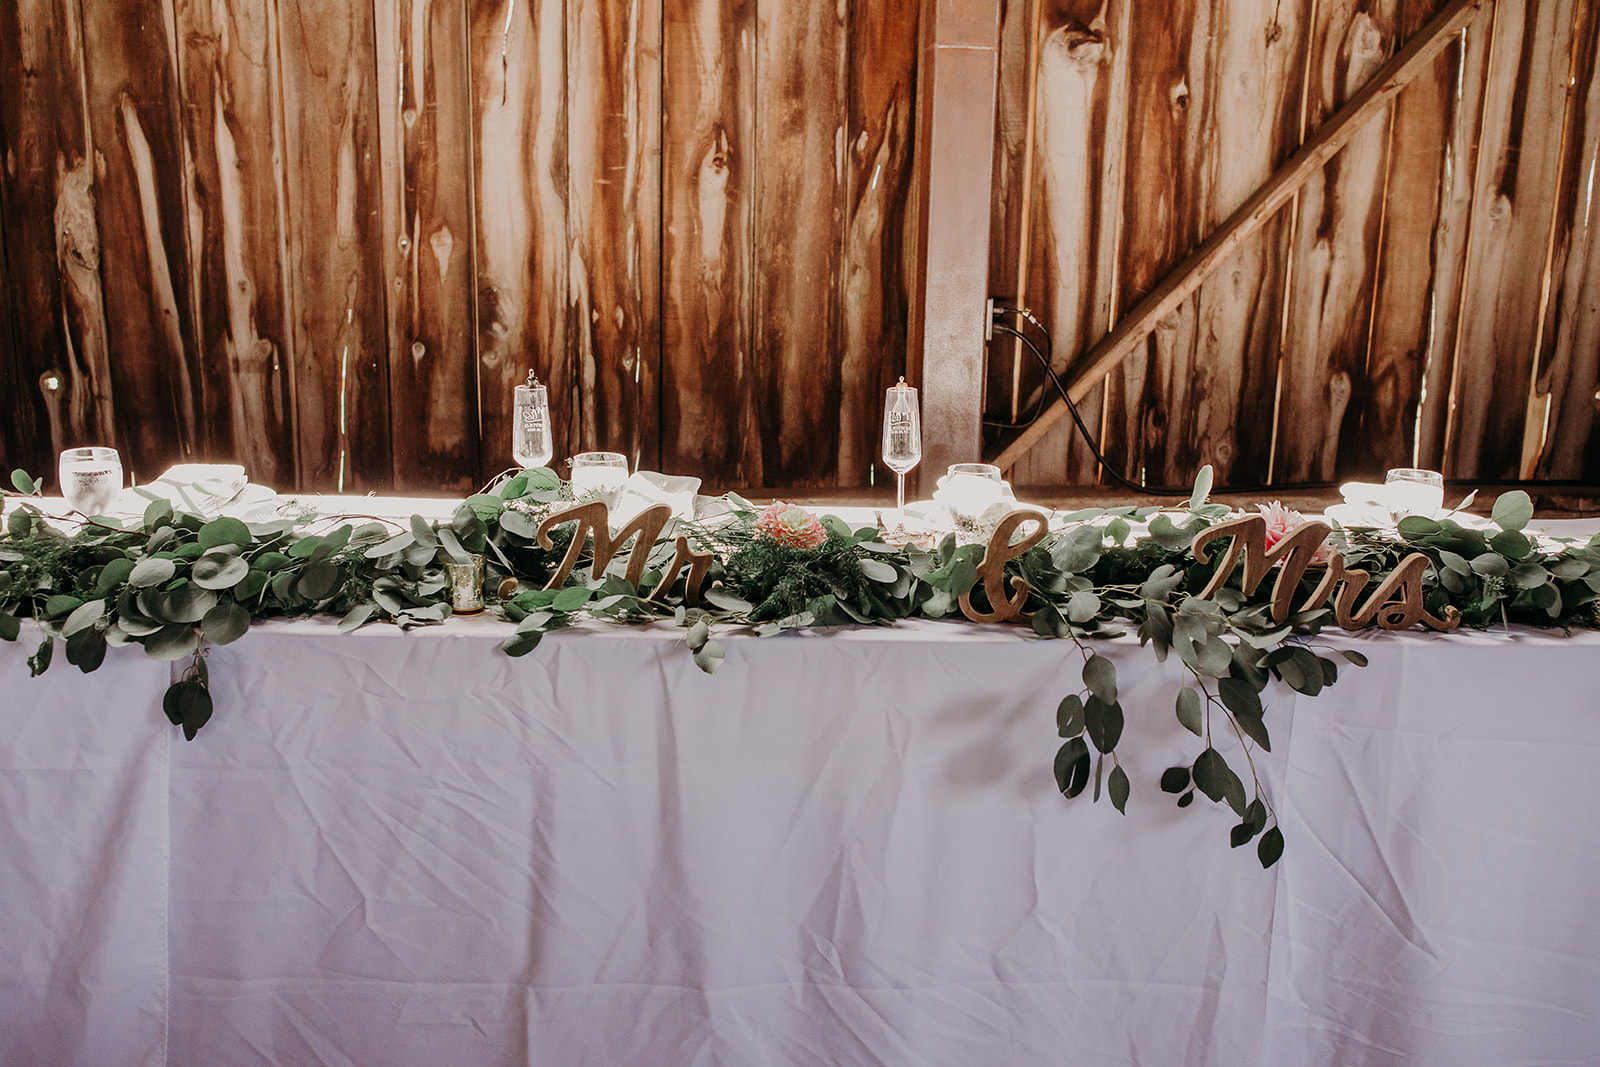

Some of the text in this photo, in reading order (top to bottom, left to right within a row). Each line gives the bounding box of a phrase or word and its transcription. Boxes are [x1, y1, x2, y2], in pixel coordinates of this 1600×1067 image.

[498, 500, 1461, 632] Mr & Mrs
